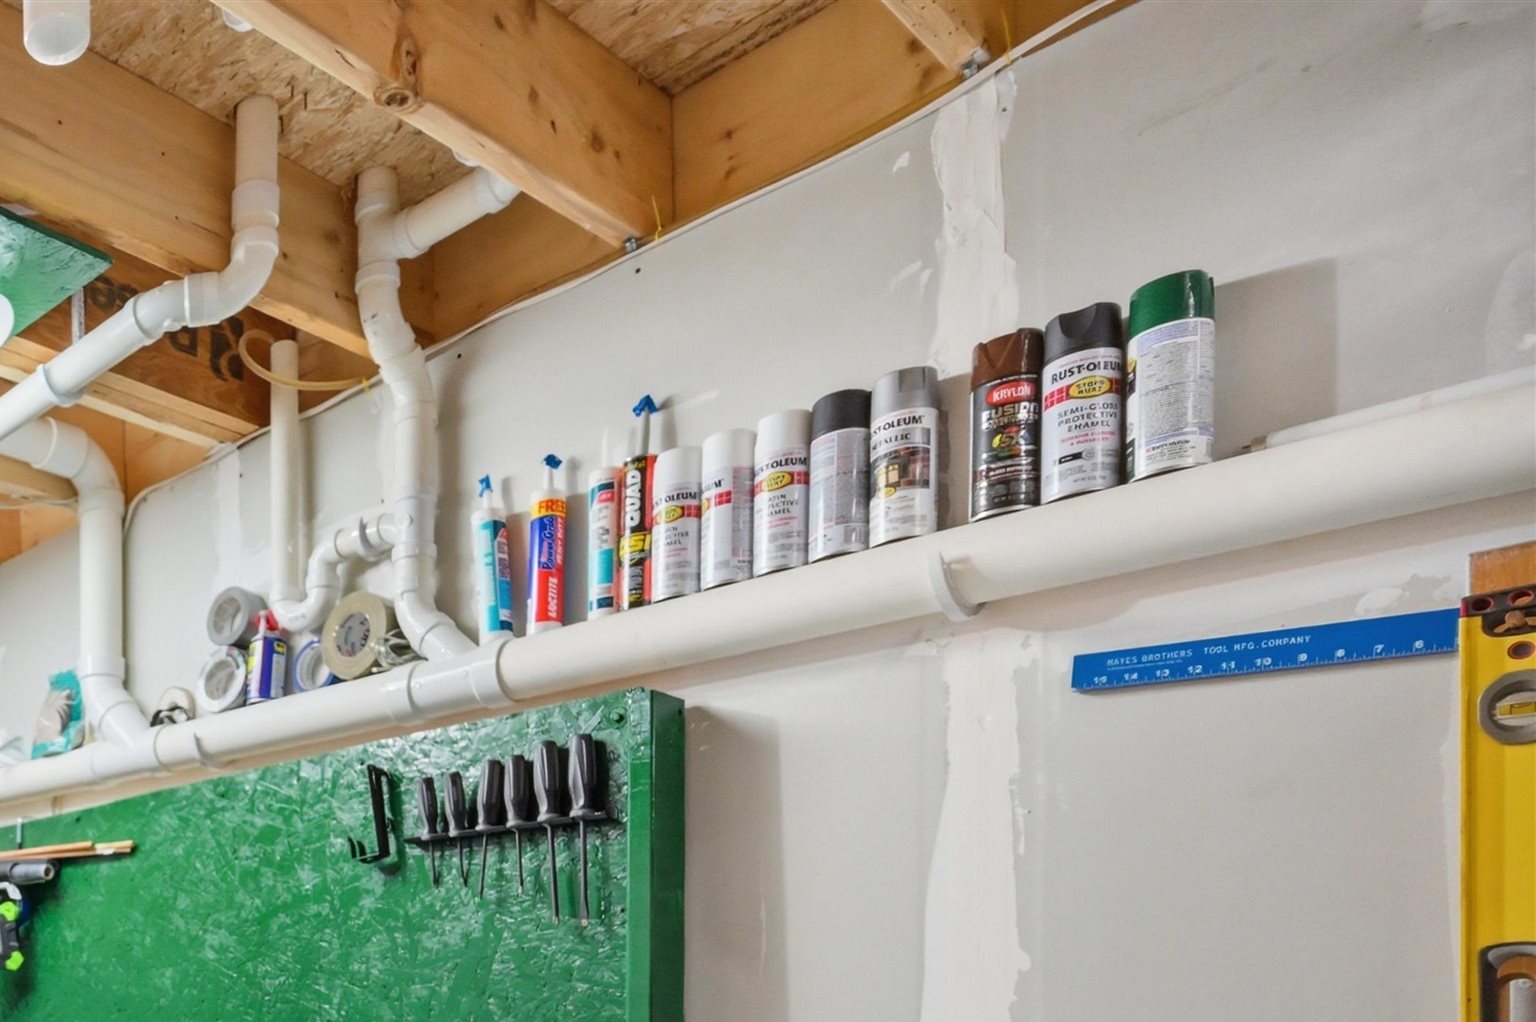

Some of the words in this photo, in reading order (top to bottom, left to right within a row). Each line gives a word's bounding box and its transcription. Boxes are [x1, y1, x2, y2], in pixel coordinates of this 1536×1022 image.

[992, 384, 1032, 402] KRYLON
[982, 401, 1039, 422] FUSION
[625, 469, 642, 528] QUAD
[547, 576, 558, 618] LOCTITE
[1141, 649, 1194, 663] BROTHERS
[1203, 646, 1229, 655] TOOL
[1261, 634, 1312, 649] COMPANY
[1187, 665, 1204, 675] 12
[1220, 660, 1236, 670] 11
[1254, 656, 1273, 667] 10
